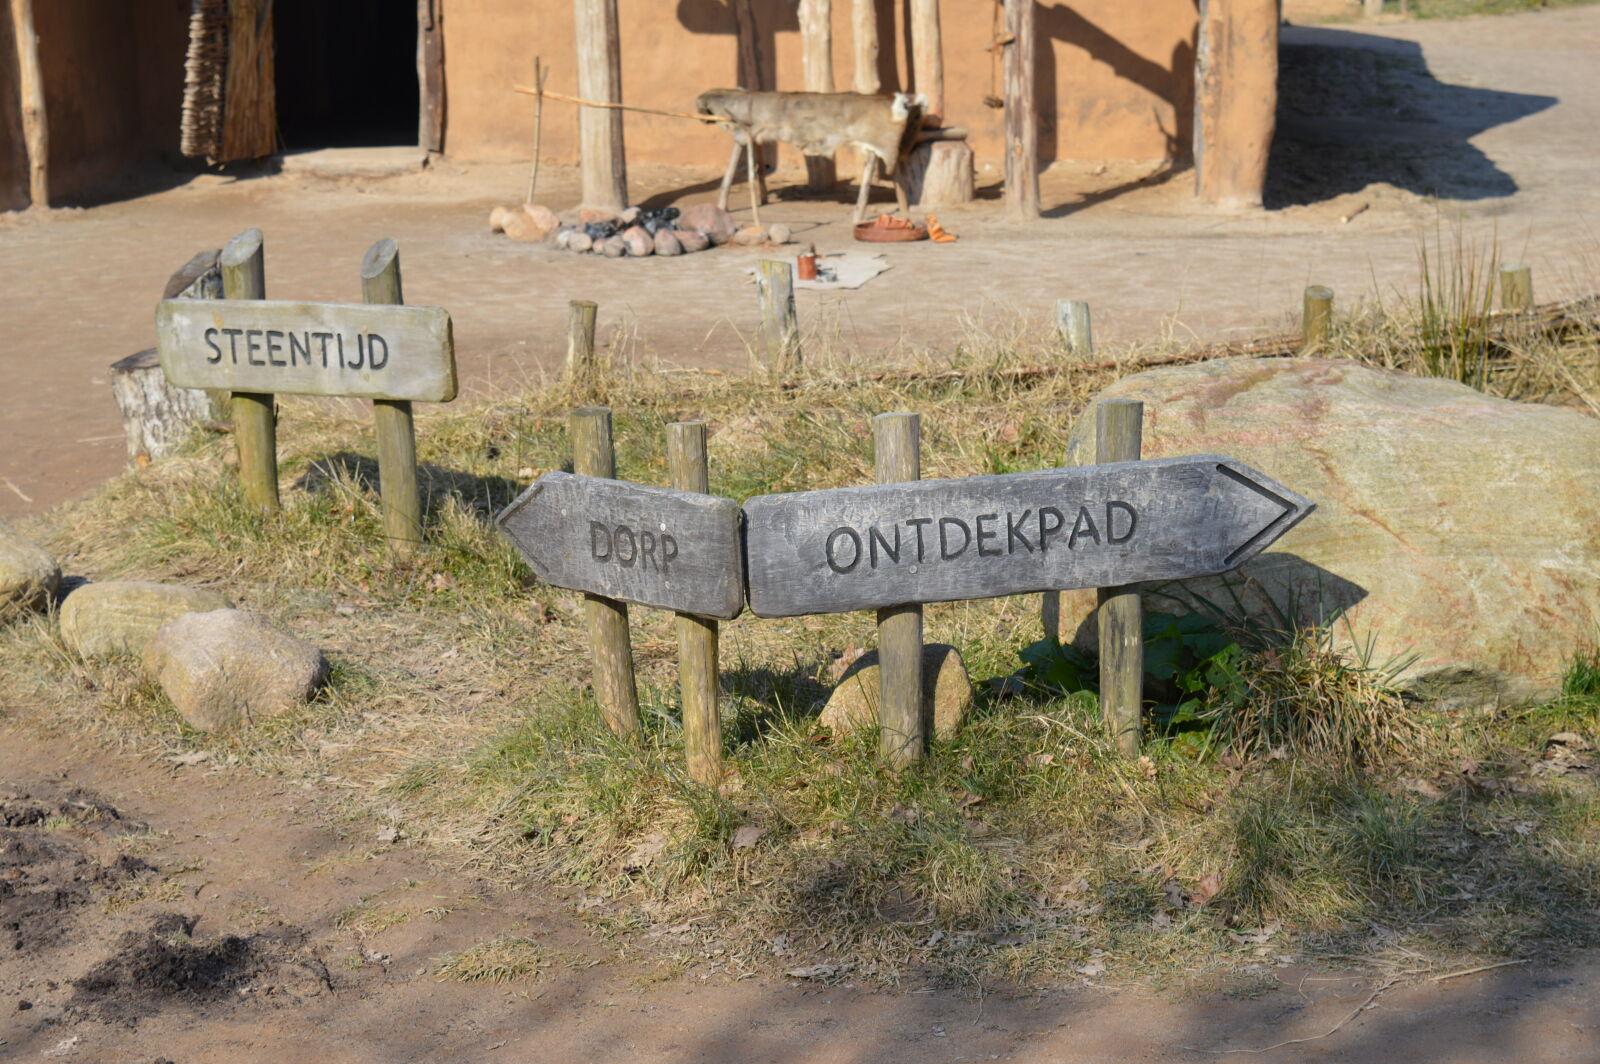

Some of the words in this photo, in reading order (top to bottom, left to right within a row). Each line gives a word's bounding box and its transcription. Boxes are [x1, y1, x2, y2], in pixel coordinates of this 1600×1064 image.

[204, 327, 389, 371] STEENTIJD
[590, 520, 679, 575] DORP
[825, 500, 1139, 574] ONTDEKPAD
